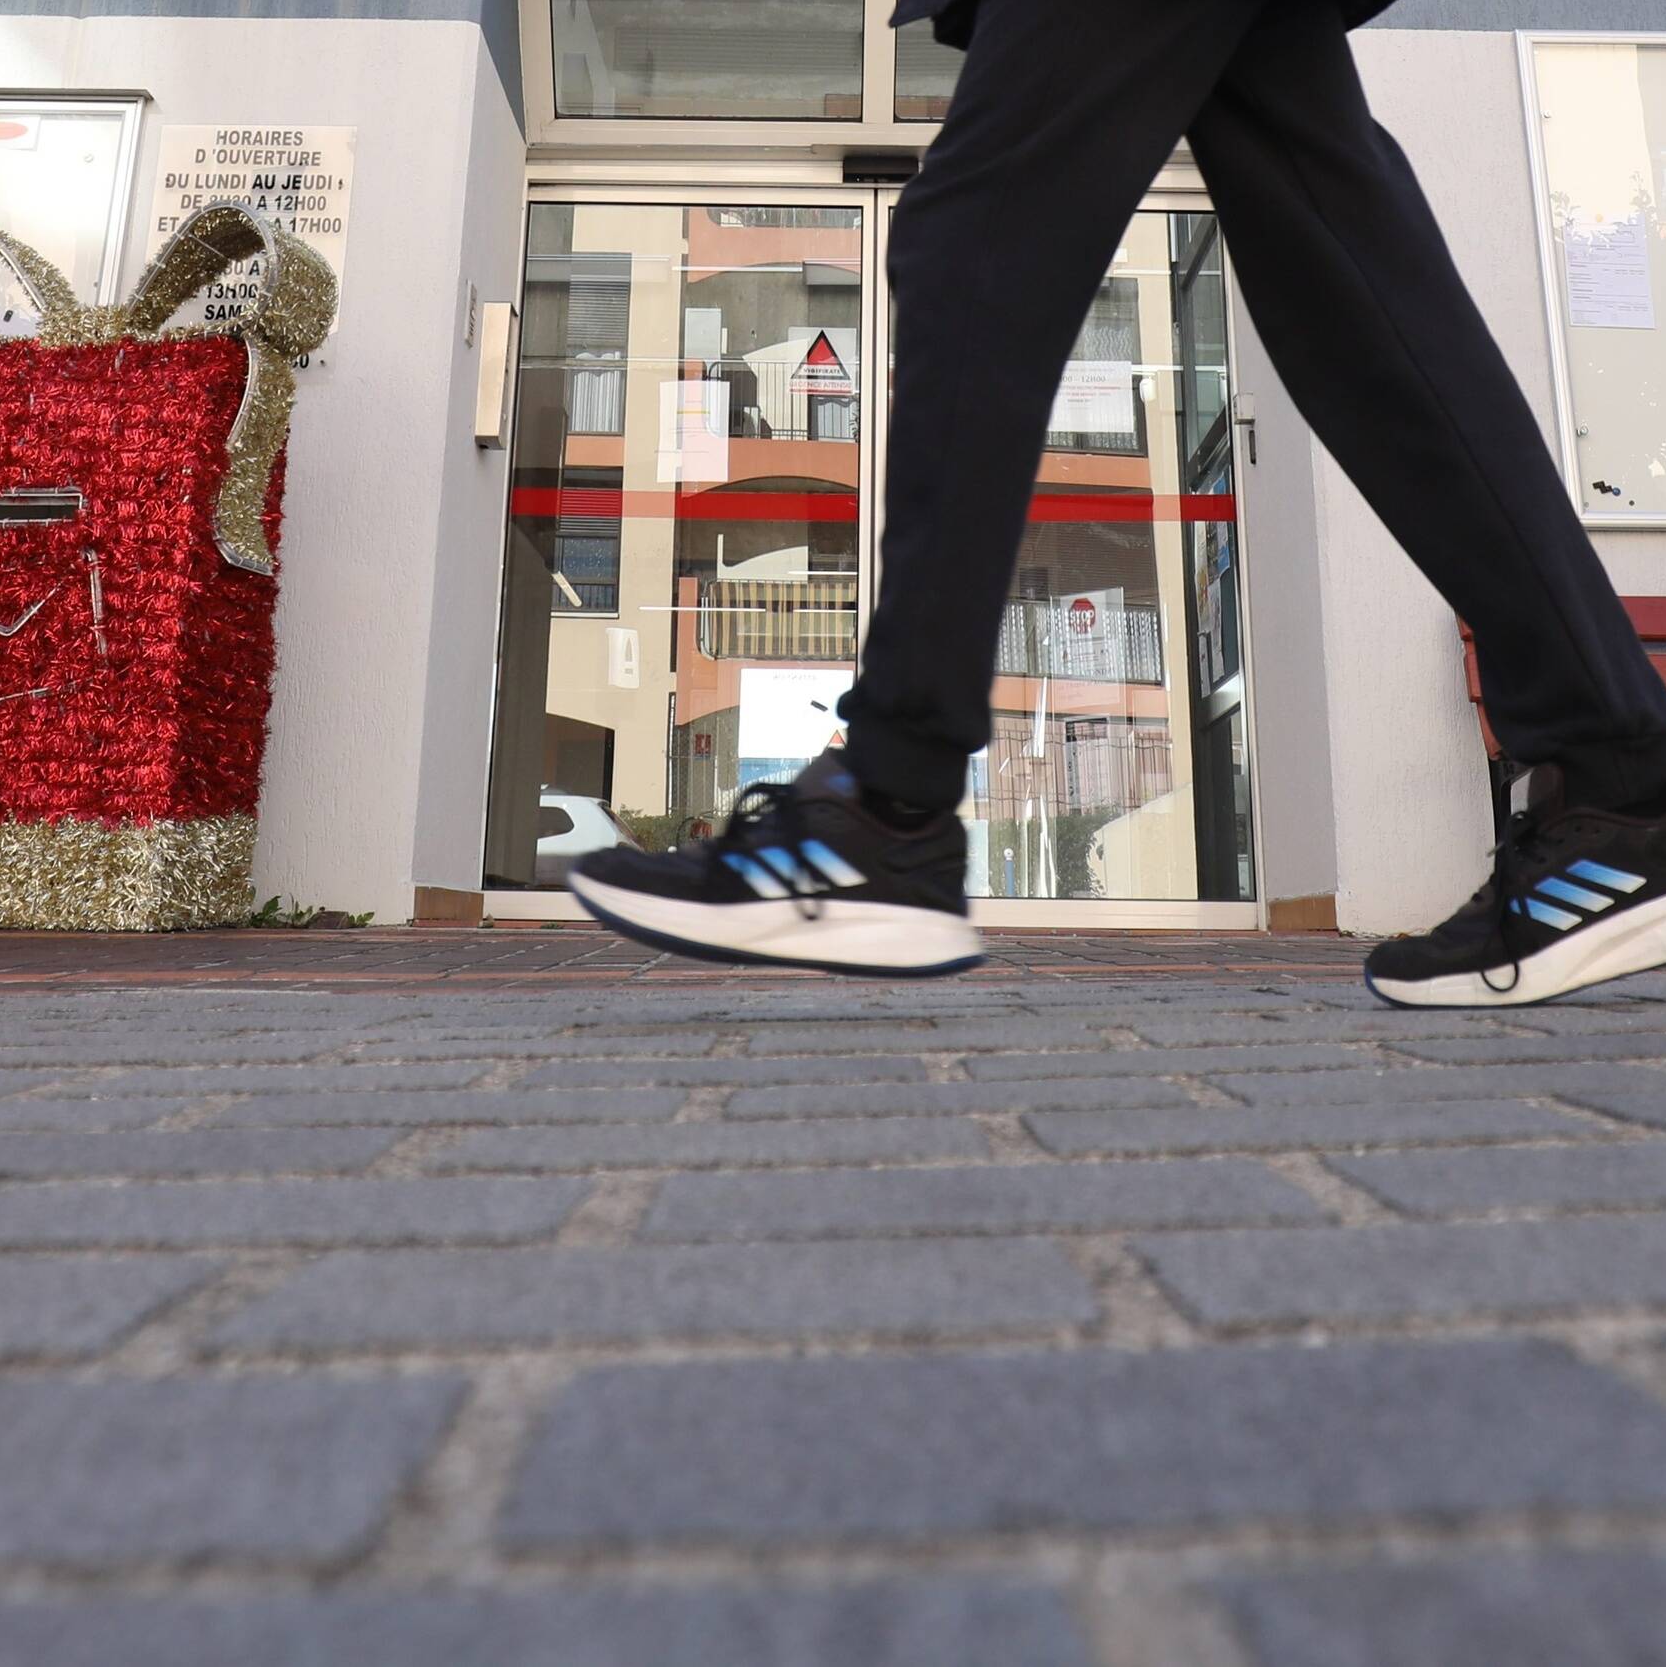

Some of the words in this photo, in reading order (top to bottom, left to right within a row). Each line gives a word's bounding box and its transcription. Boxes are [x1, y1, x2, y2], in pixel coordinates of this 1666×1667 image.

[215, 130, 304, 146] HORAIRES
[165, 173, 190, 190] DU
[195, 173, 247, 190] LUNDI
[251, 174, 277, 191] AU
[281, 174, 333, 191] JEUDI
[180, 194, 203, 210] DE
[256, 195, 268, 211] A
[274, 195, 327, 211] 12H00
[158, 216, 180, 233] ET
[288, 217, 343, 234] 17H00
[248, 260, 261, 277] A
[206, 283, 259, 300] 13H00
[204, 304, 242, 321] SAM
[1069, 609, 1095, 625] STOP
